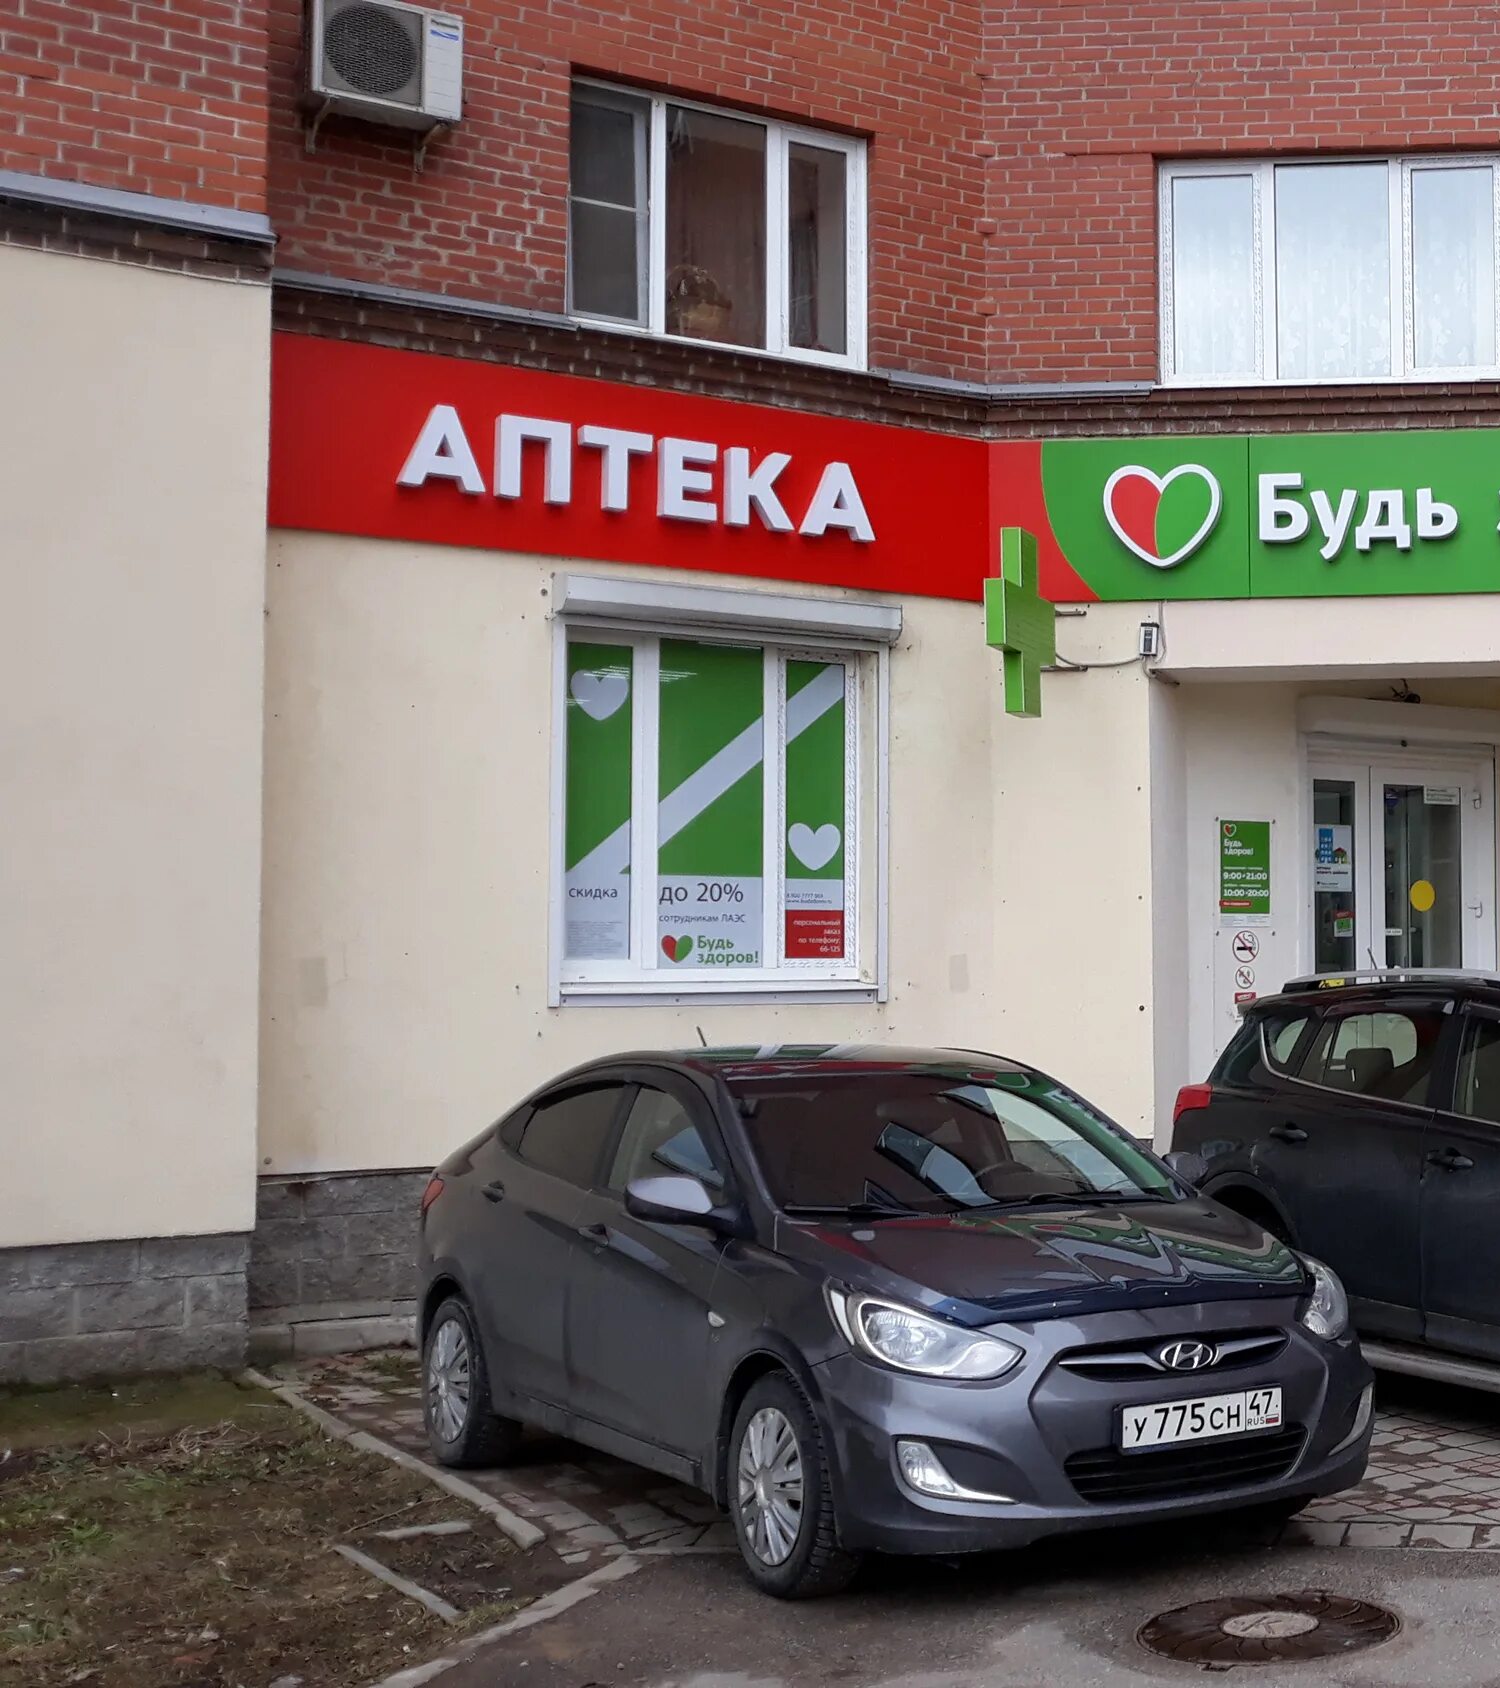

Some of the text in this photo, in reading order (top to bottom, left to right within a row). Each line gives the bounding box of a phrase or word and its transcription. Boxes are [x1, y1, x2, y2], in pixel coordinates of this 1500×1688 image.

[395, 403, 876, 543] АПТЕКА
[1257, 472, 1459, 562] Будь
[1224, 838, 1242, 849] Будь
[1224, 847, 1254, 856] здоров!
[568, 887, 618, 900] скидка
[659, 882, 744, 905] до 20%
[659, 913, 746, 924] сотрудникам ЛАЭС
[697, 935, 734, 952] Будь
[697, 951, 759, 966] здоров!
[1249, 1391, 1273, 1416] 47
[1247, 1416, 1265, 1426] RUS
